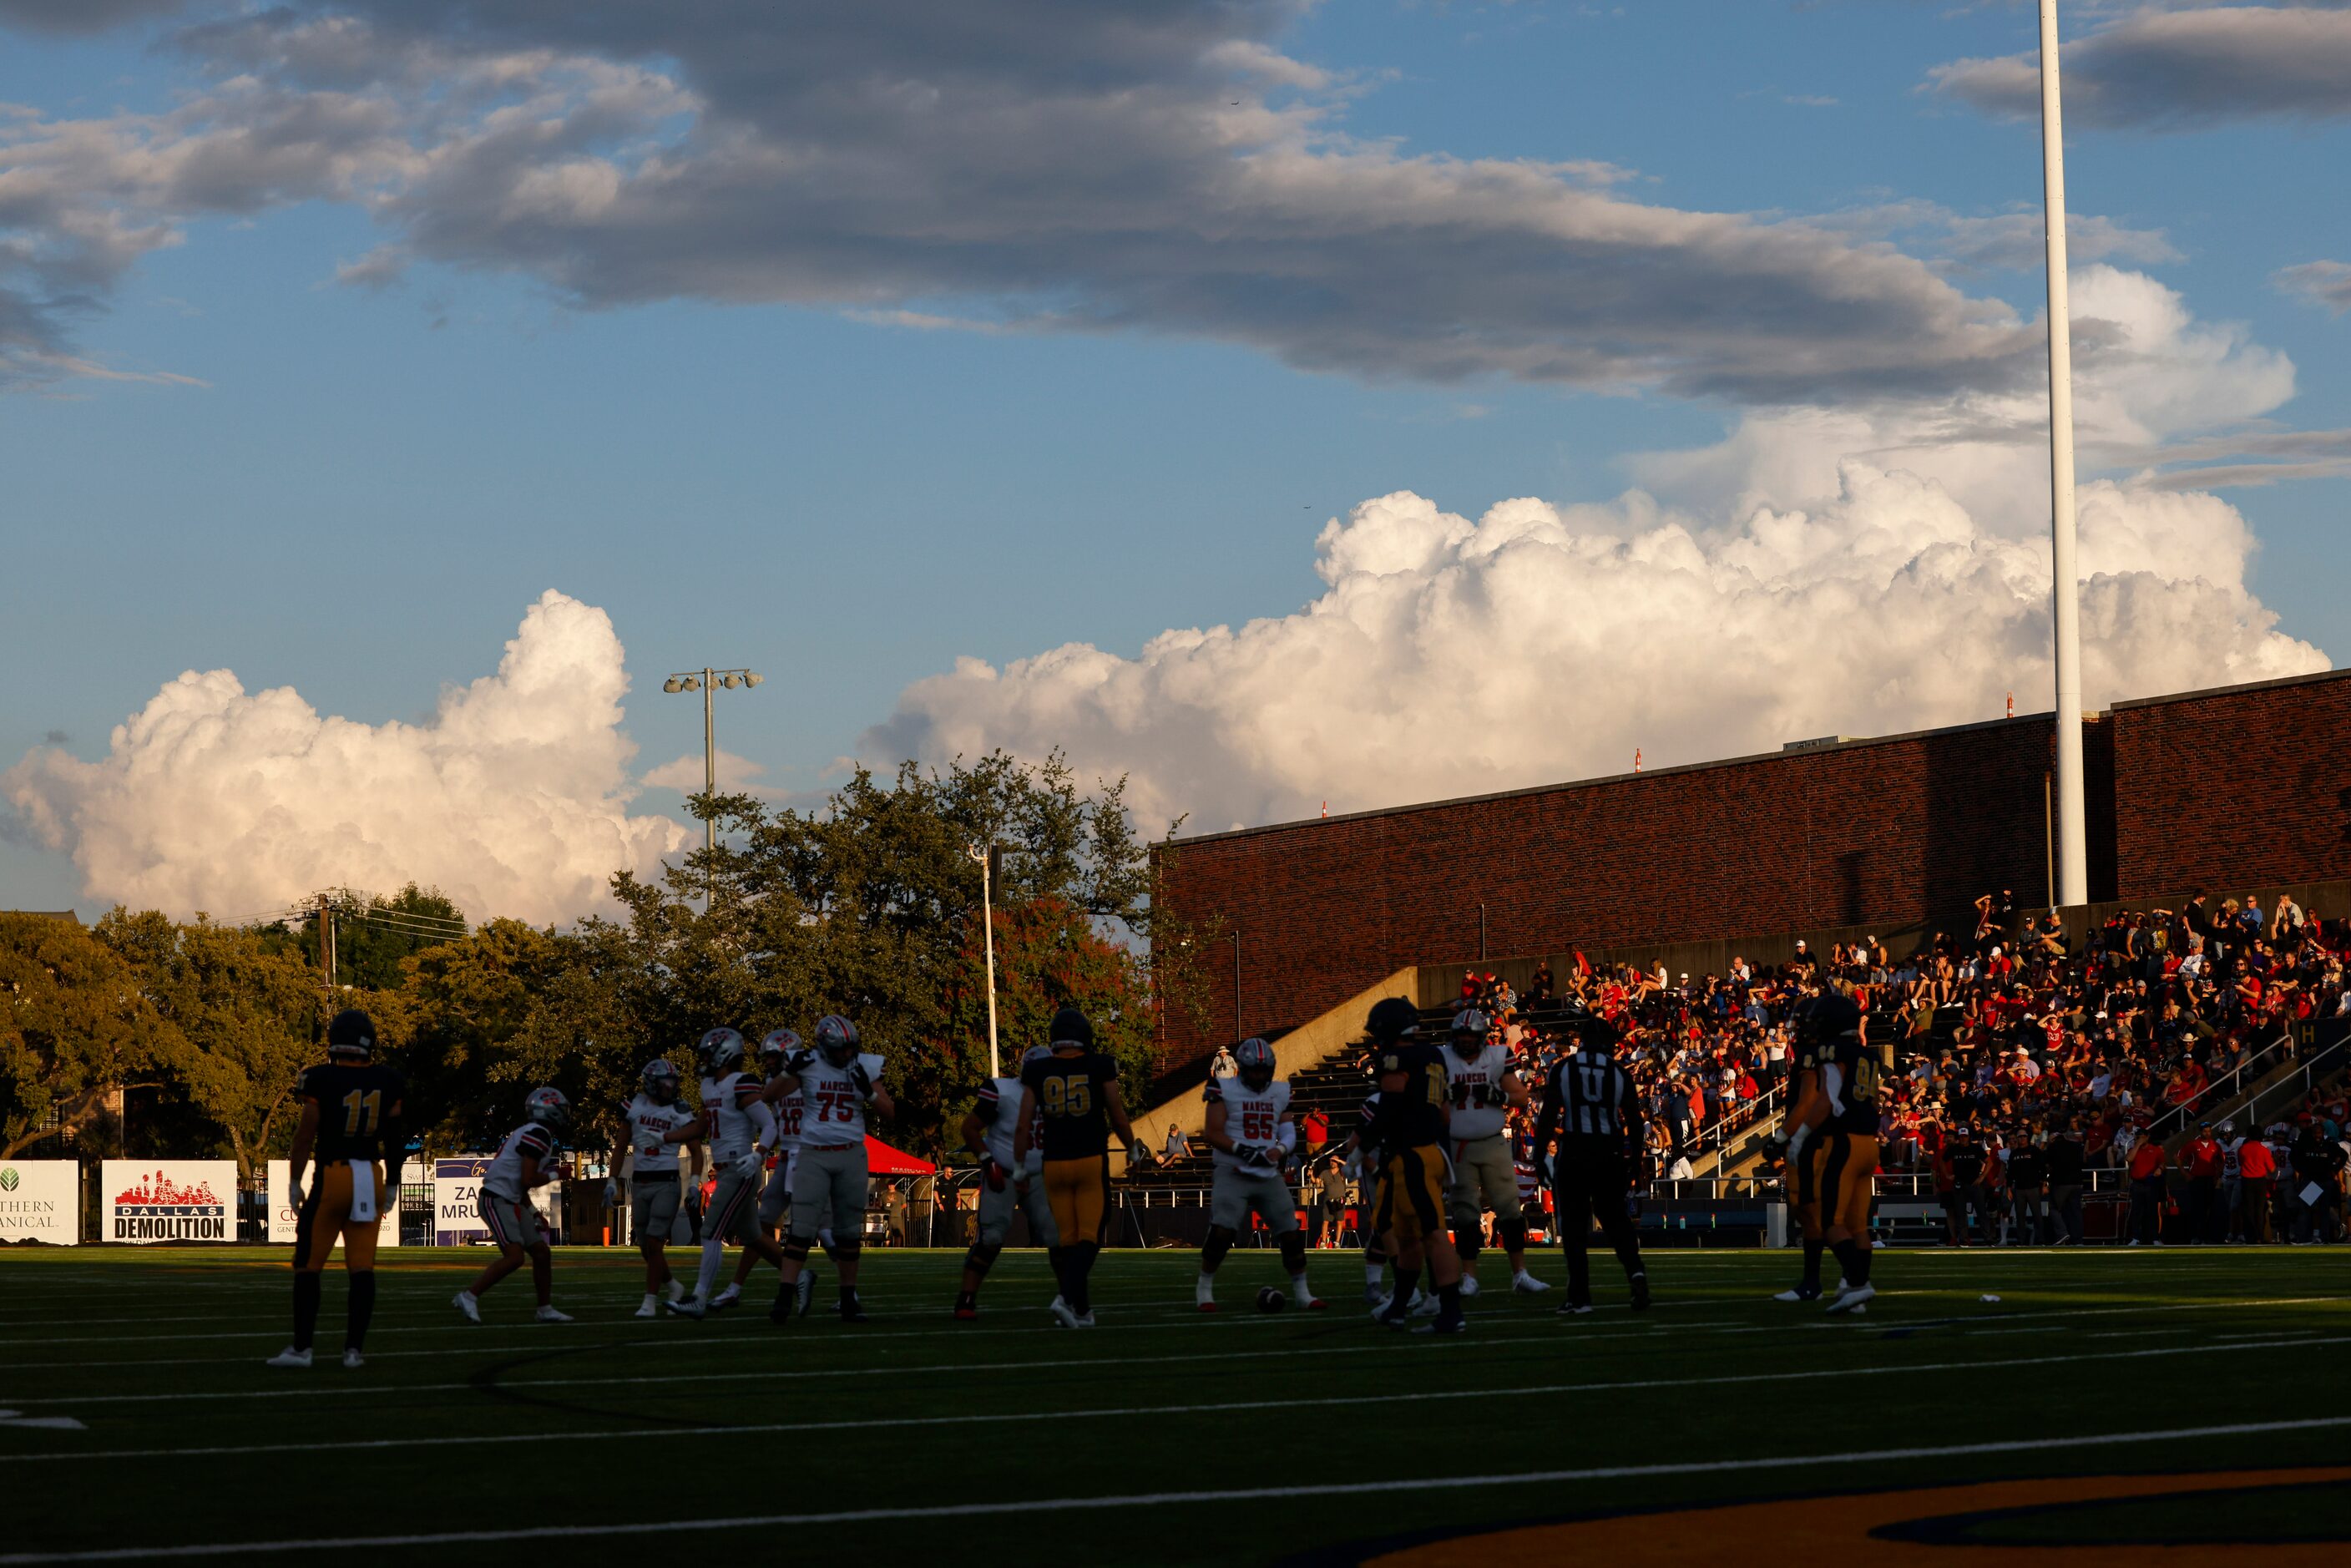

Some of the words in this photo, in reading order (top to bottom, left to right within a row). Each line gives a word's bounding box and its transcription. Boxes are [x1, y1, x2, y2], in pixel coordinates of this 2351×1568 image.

[2302, 1024, 2315, 1044] H
[820, 1080, 853, 1092] MARCUS
[1454, 1072, 1487, 1085] MARCUS
[1579, 1065, 1605, 1103] U
[816, 1092, 855, 1121] 75
[1043, 1074, 1091, 1119] 95
[1242, 1101, 1273, 1111] MARCUS
[342, 1089, 382, 1137] 11
[640, 1115, 671, 1130] MARCUS
[1243, 1113, 1274, 1140] 55
[122, 1207, 217, 1216] DALLAS
[114, 1217, 225, 1239] DEMOLITION
